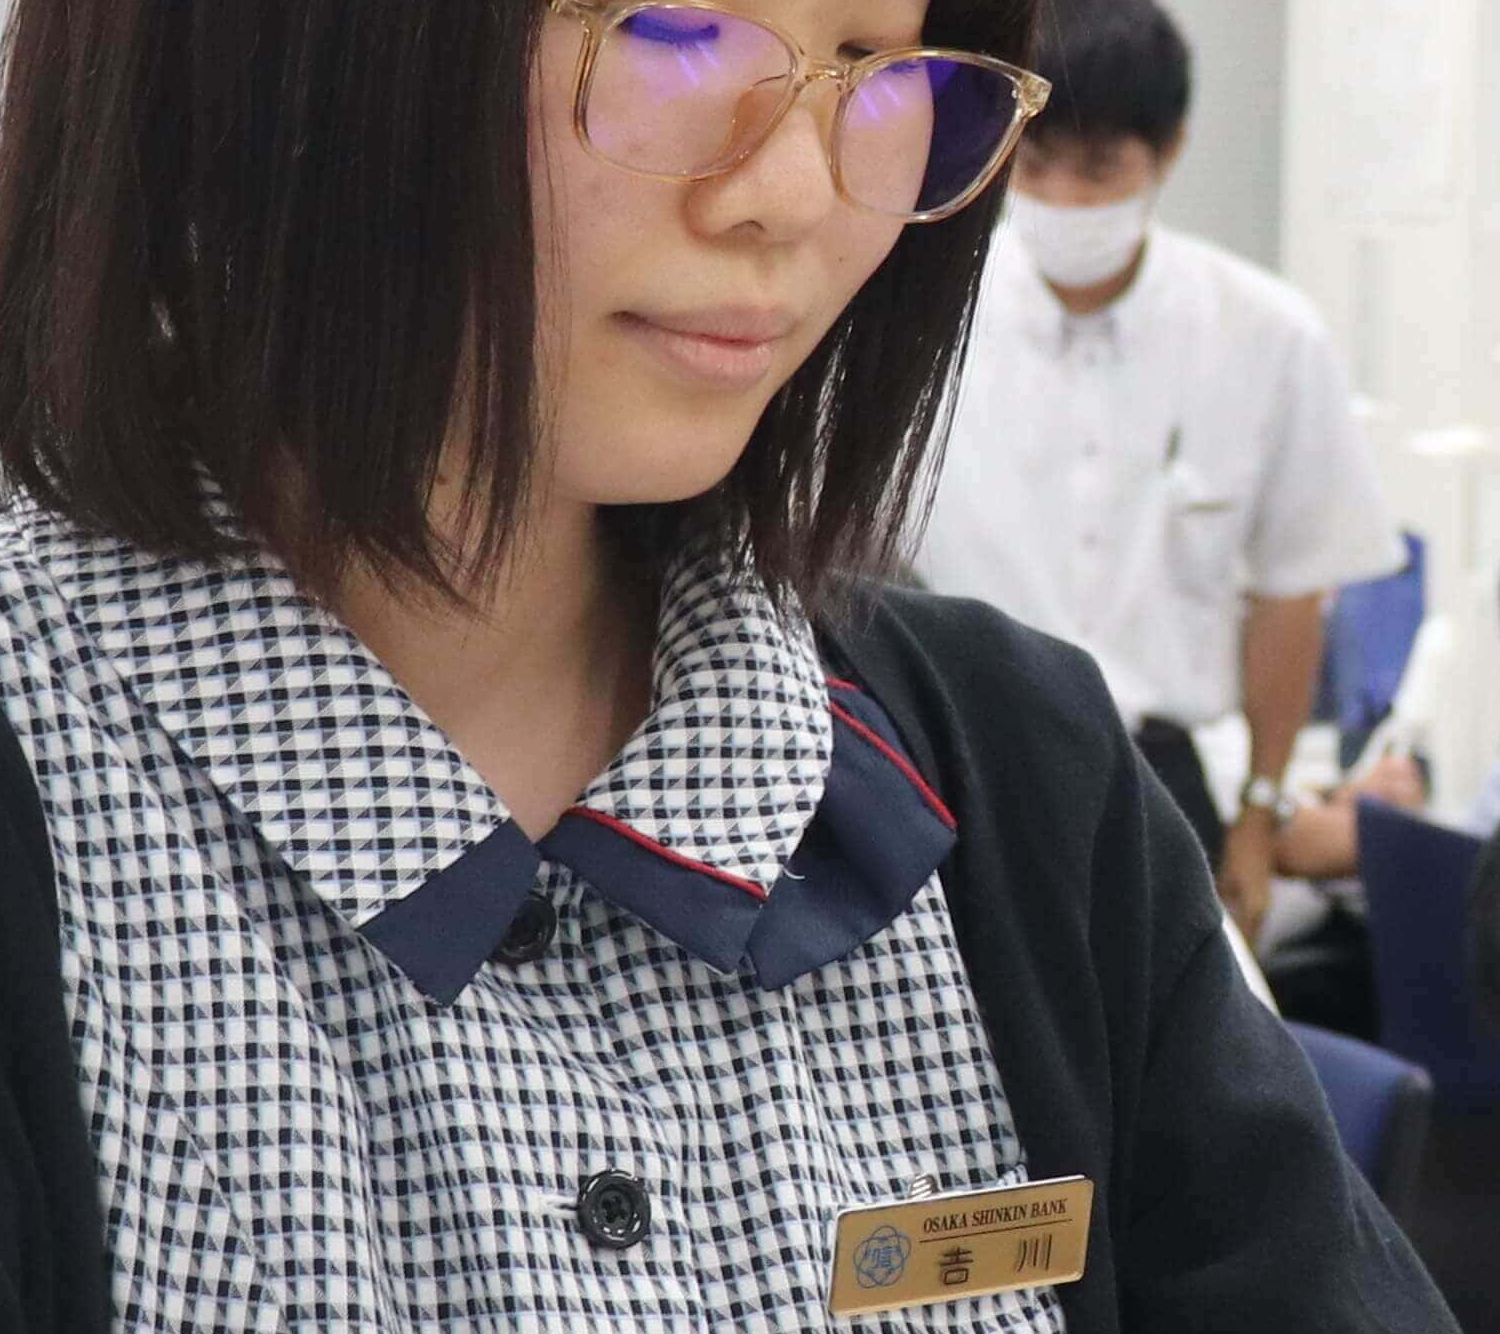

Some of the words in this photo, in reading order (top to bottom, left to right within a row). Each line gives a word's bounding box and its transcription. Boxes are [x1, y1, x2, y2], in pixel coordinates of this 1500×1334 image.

[923, 1214, 968, 1233] OSAKA
[972, 1204, 1028, 1227] SHINKIN
[1030, 1198, 1068, 1217] BANK
